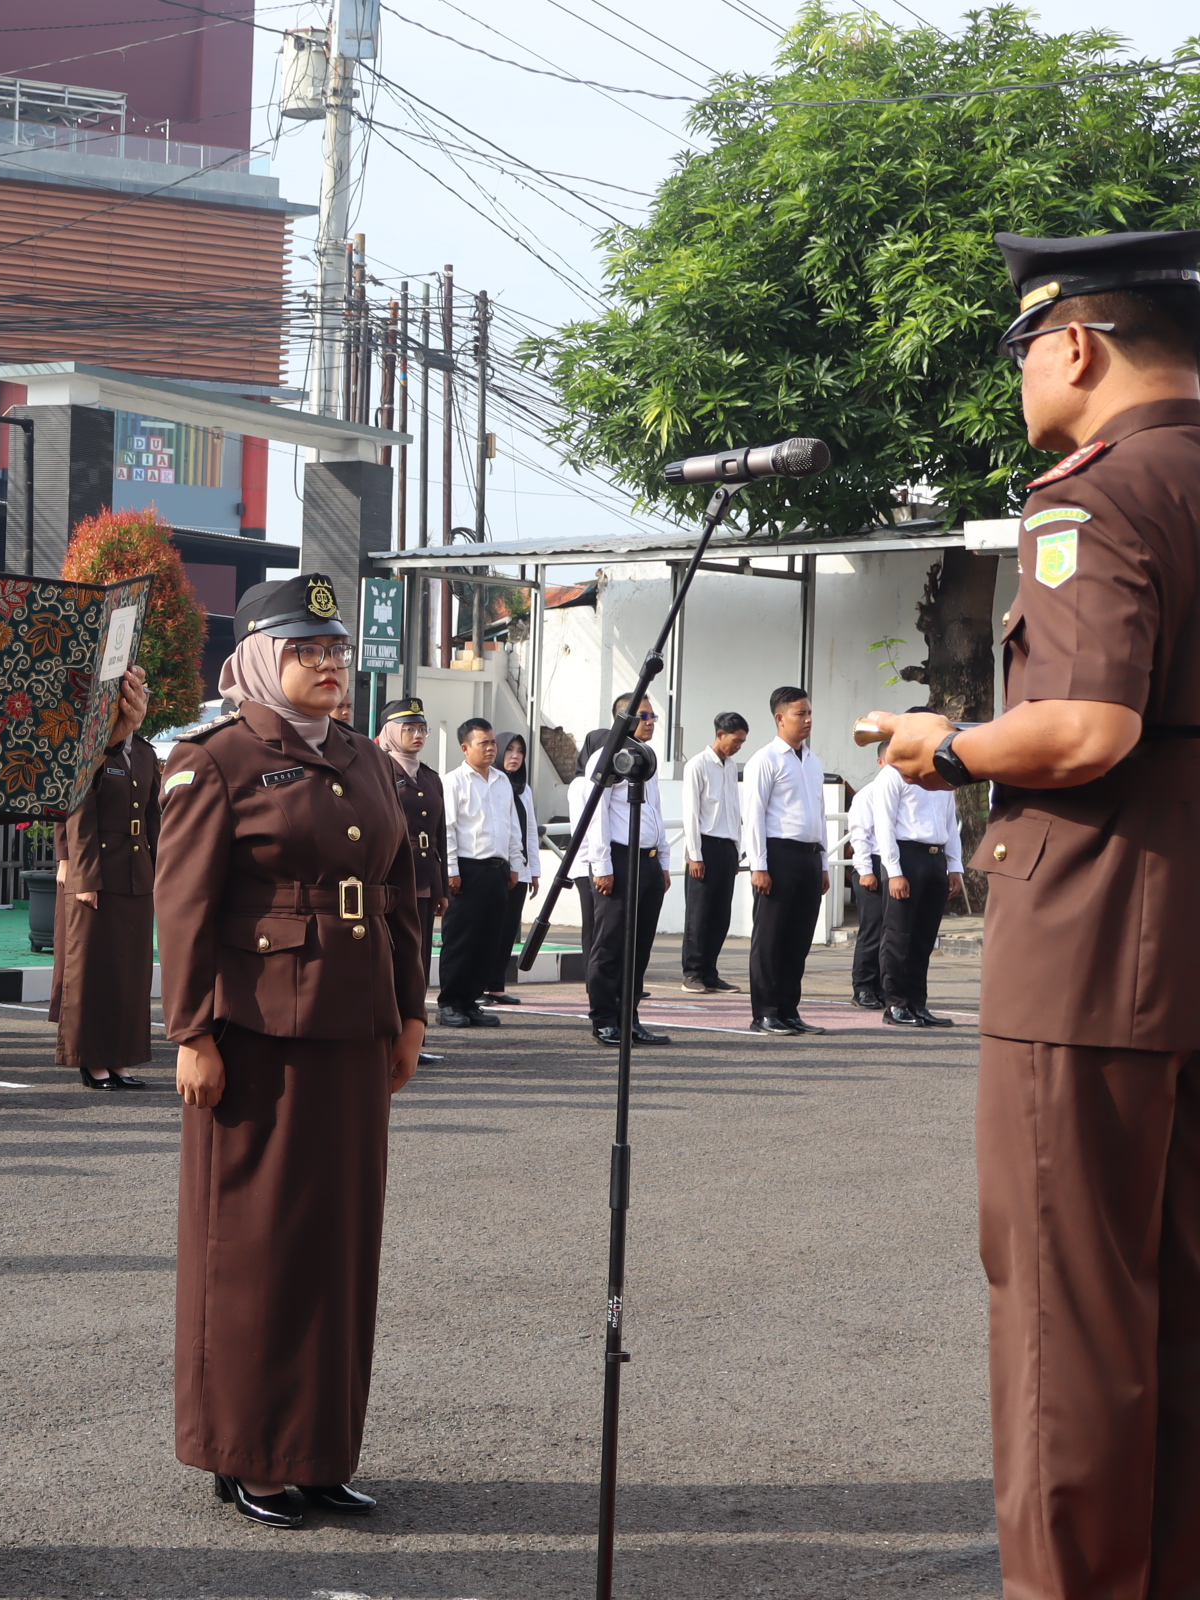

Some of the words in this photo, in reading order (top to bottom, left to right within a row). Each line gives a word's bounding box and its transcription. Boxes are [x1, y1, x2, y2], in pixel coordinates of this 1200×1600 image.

[117, 468, 172, 482] ANAK
[364, 645, 377, 657] TITIK
[378, 645, 398, 659] KUMPUL
[274, 771, 296, 781] ROSI
